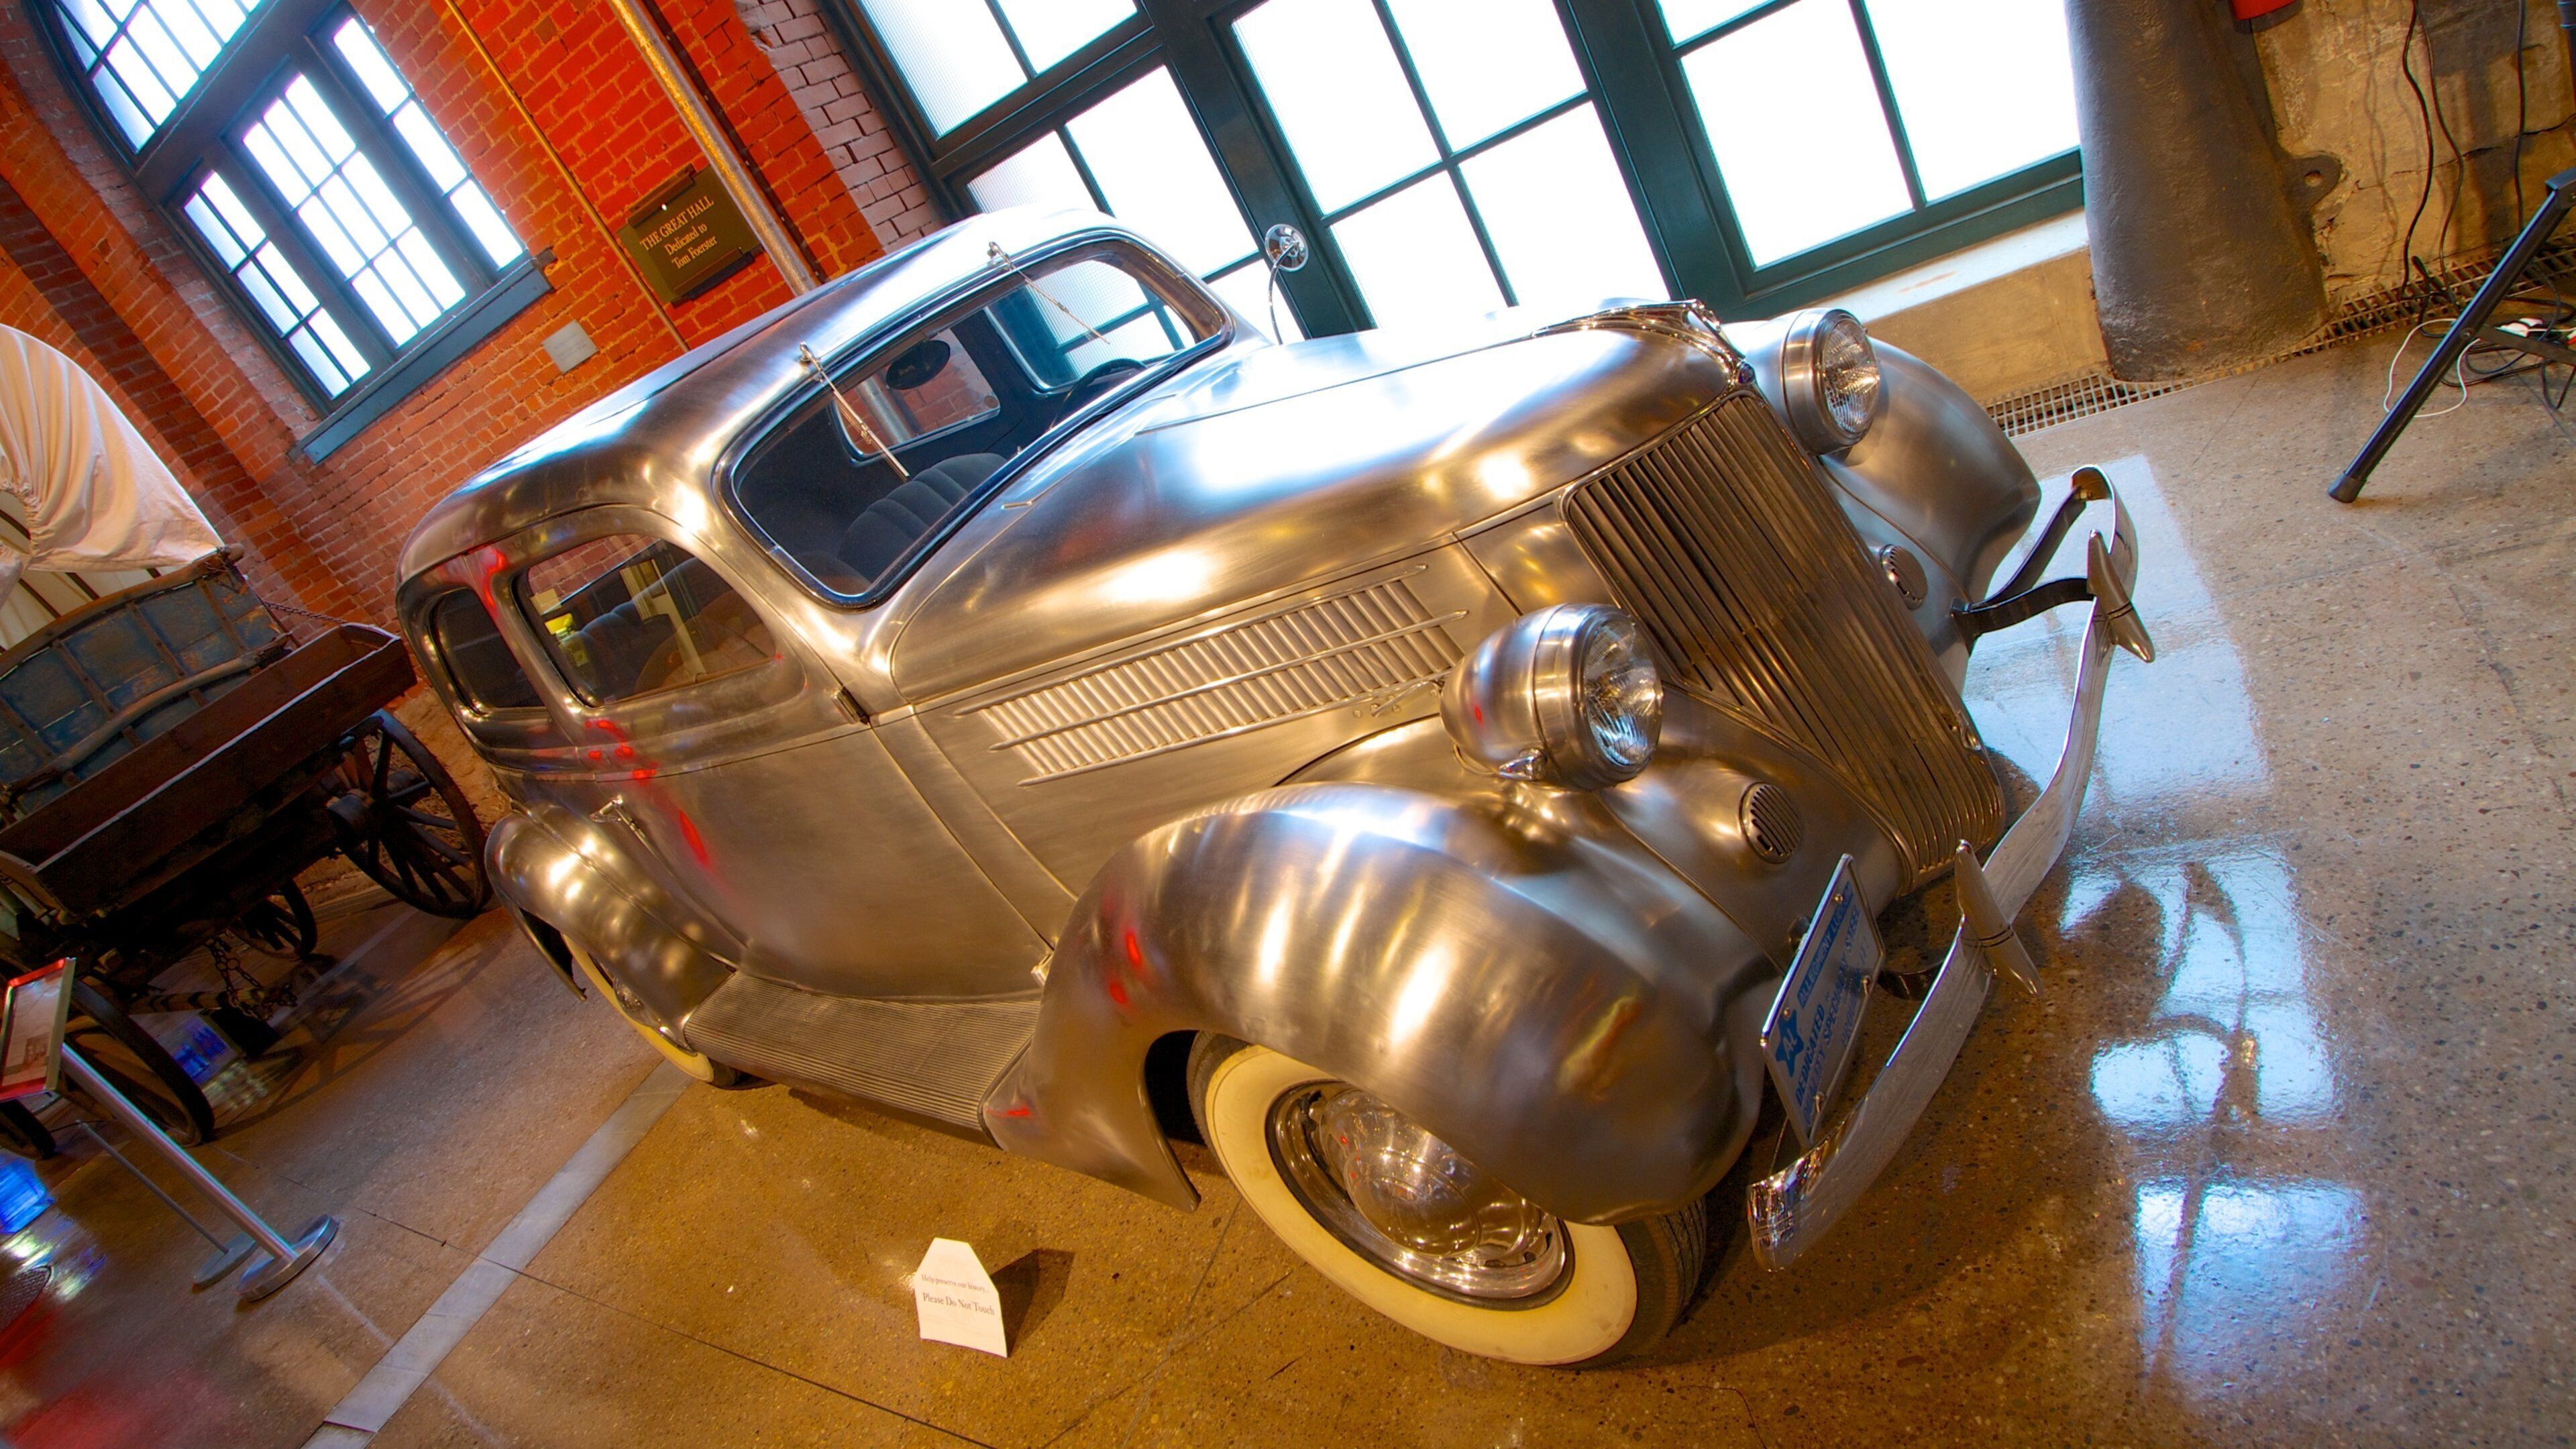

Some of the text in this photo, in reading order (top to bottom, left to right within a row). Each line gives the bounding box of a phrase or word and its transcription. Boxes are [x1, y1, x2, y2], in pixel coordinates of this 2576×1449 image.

[640, 196, 714, 250] THE GREAT HALL
[665, 224, 708, 255] Dedicated to
[672, 235, 718, 268] Tom Foerster
[1844, 903, 1860, 954] STEEL
[1799, 928, 1833, 1008] ALLEGHENY
[1794, 1002, 1825, 1106] DEDICATED
[923, 1292, 995, 1316] Please Do Not Touch
